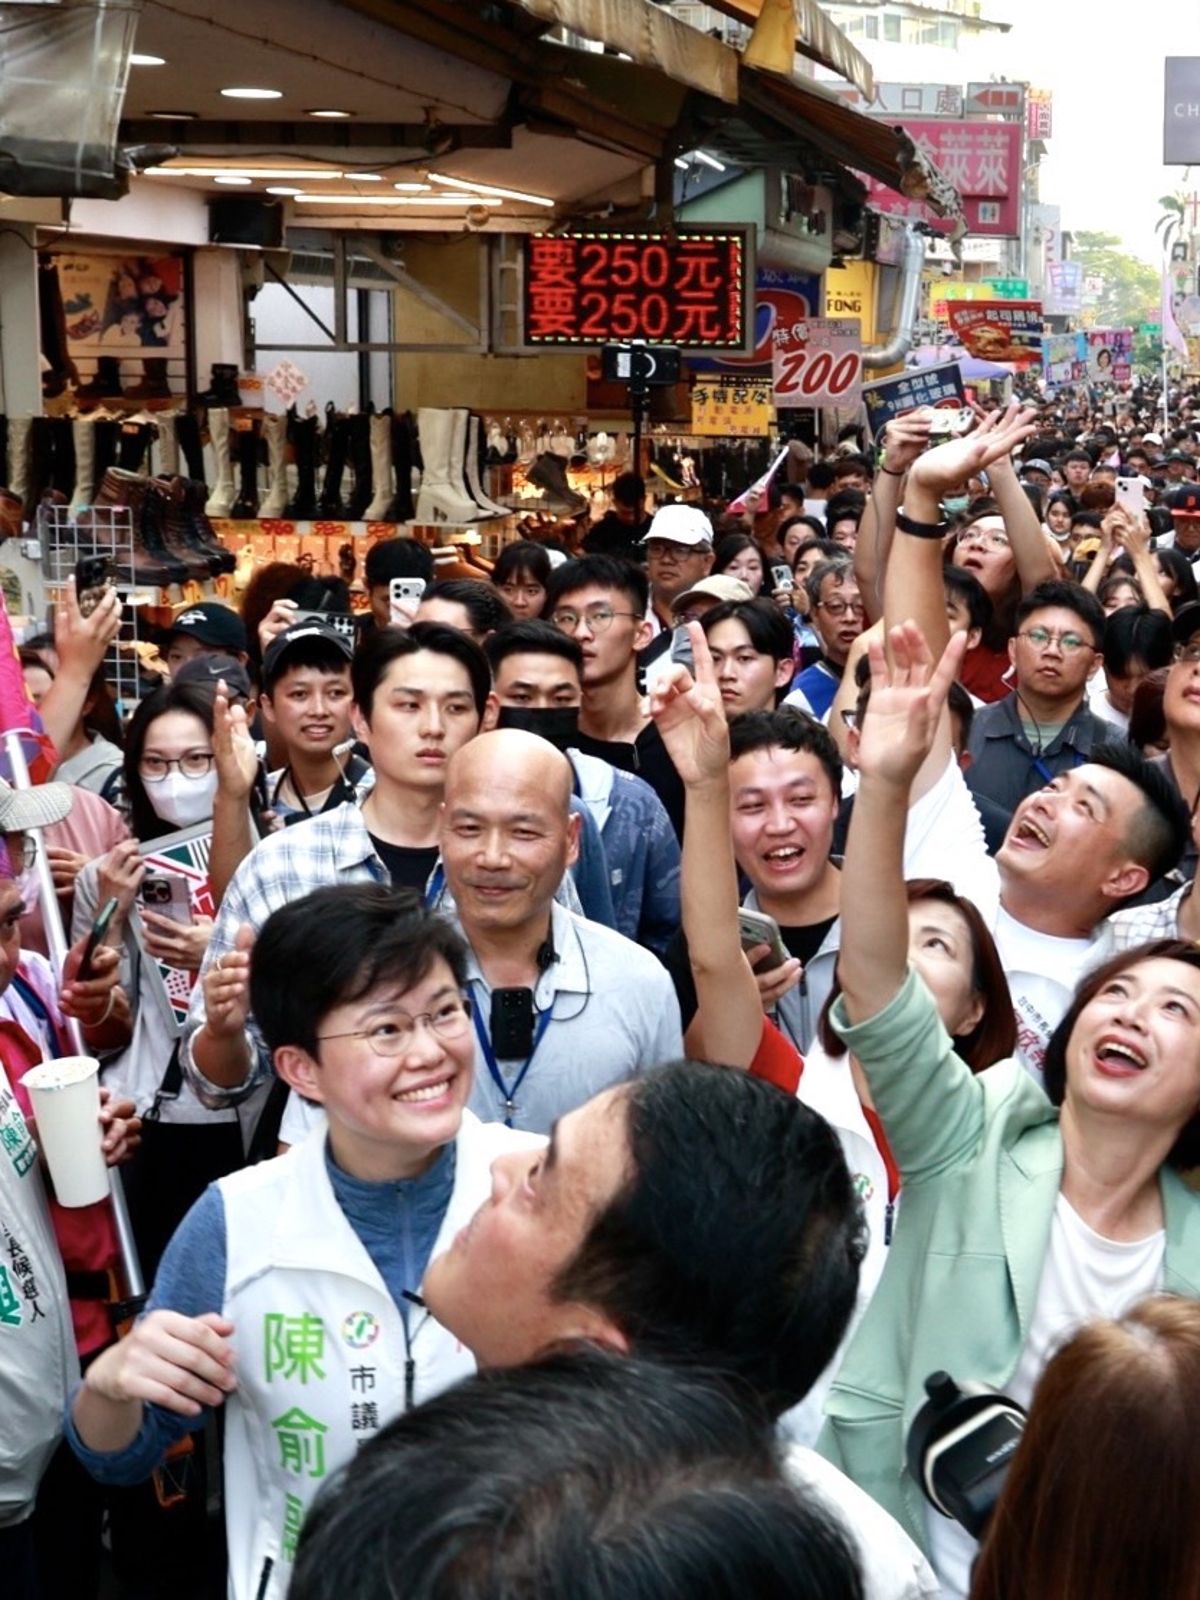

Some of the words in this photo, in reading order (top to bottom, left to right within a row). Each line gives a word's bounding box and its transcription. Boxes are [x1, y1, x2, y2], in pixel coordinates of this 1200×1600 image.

[864, 84, 961, 113] 入口處
[530, 239, 737, 289] 要250元
[530, 286, 737, 338] 要250元
[826, 299, 861, 312] FONG
[774, 352, 861, 395] 200
[2, 1222, 46, 1323] 長候選人
[349, 1365, 378, 1450] 市議
